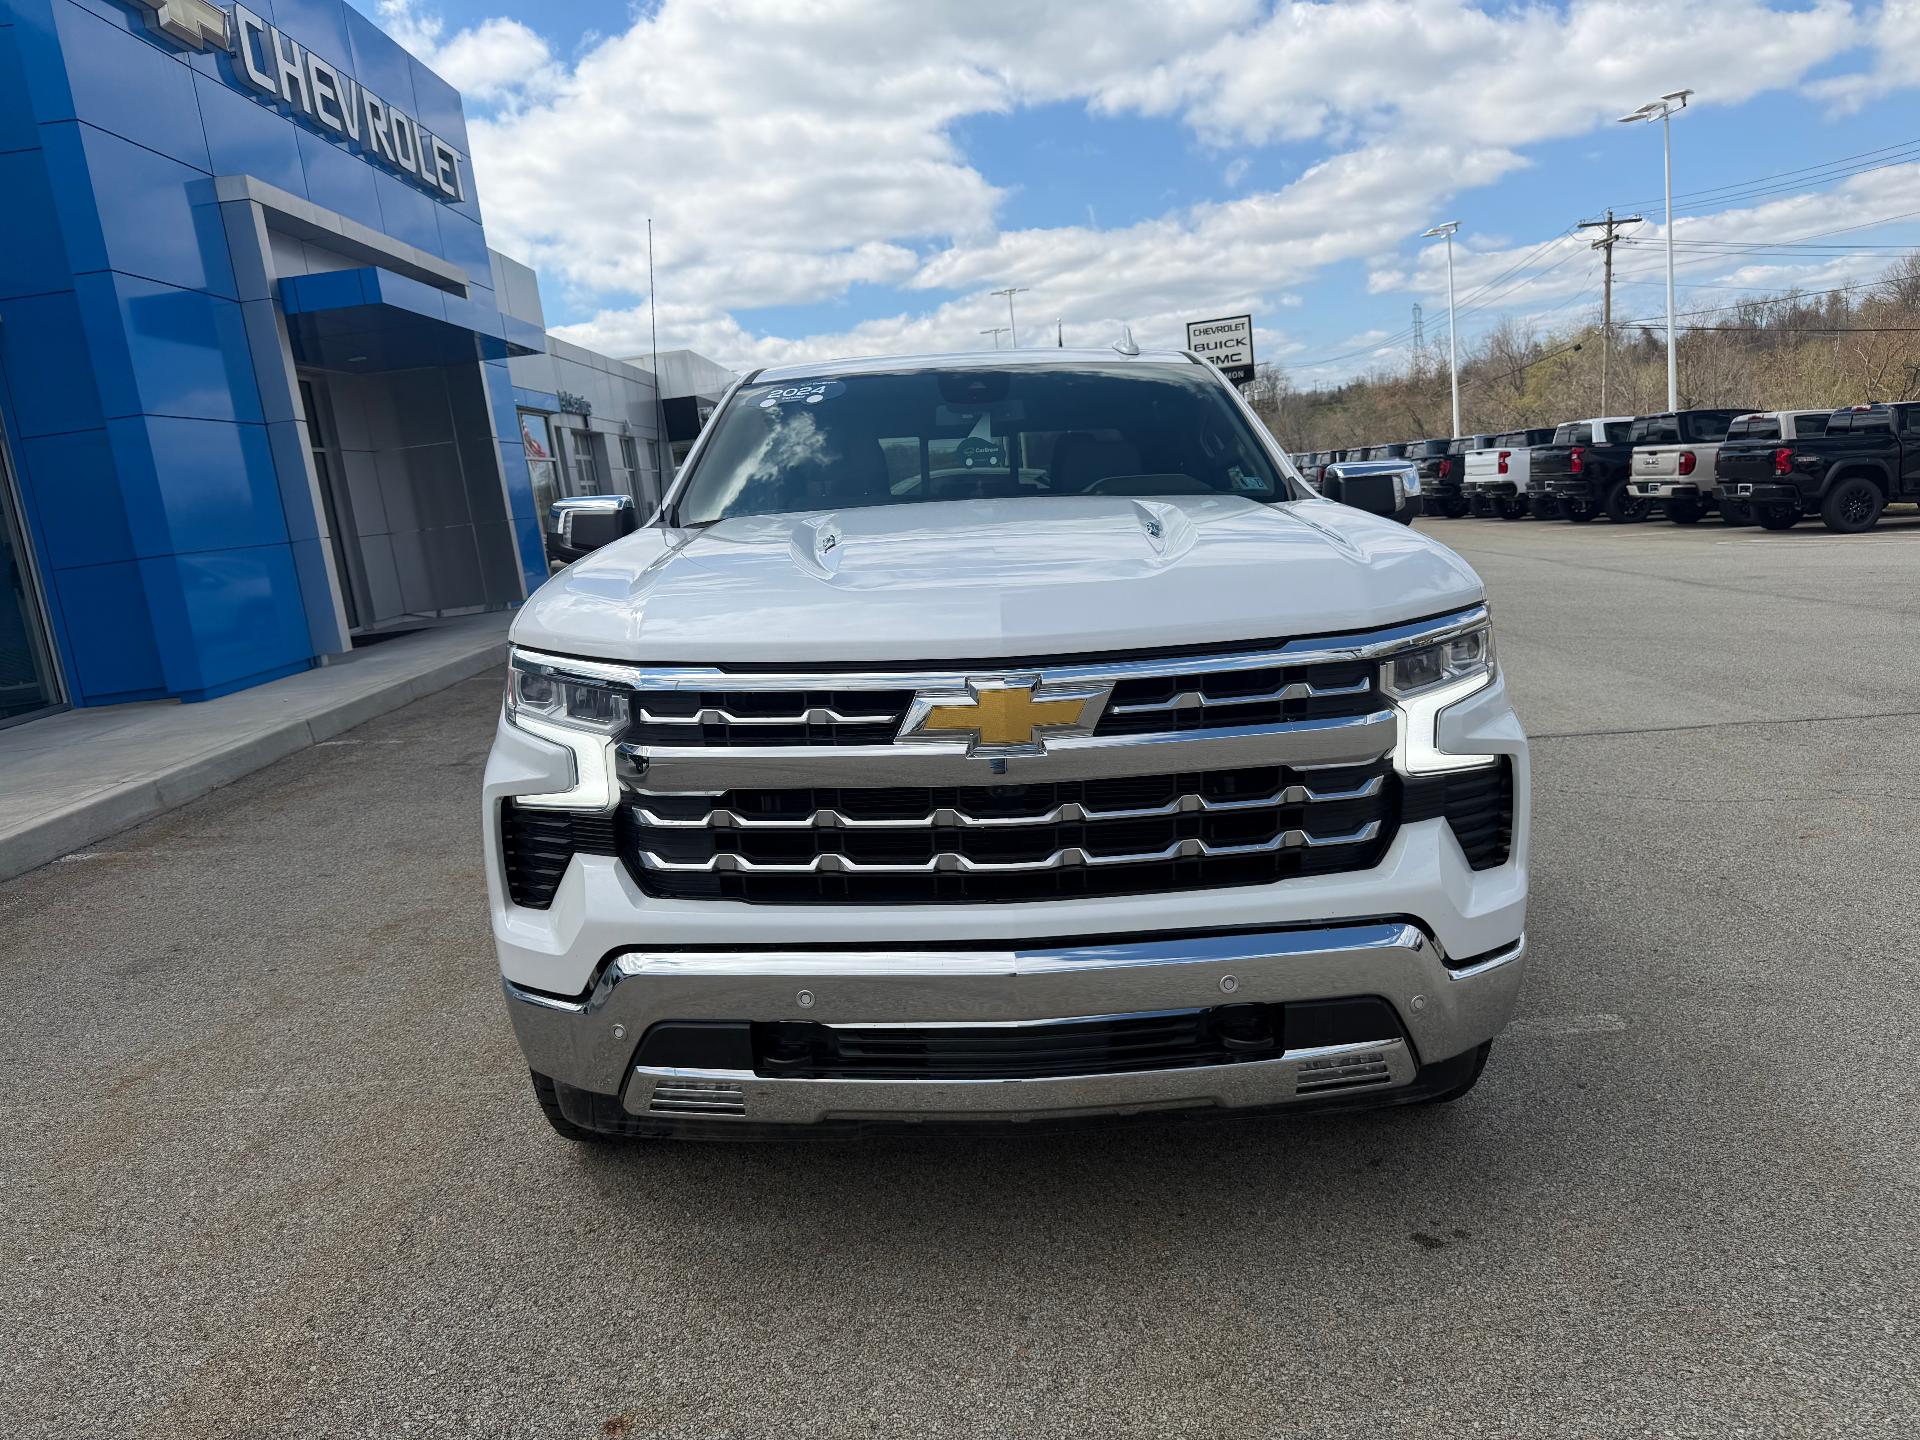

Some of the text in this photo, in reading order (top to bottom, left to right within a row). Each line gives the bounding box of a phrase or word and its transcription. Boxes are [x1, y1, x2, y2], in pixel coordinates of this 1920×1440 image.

[232, 2, 466, 203] CHEVROLET
[1193, 323, 1246, 336] CHEVROLET
[1194, 337, 1247, 352] BUICK
[767, 386, 826, 398] 2024
